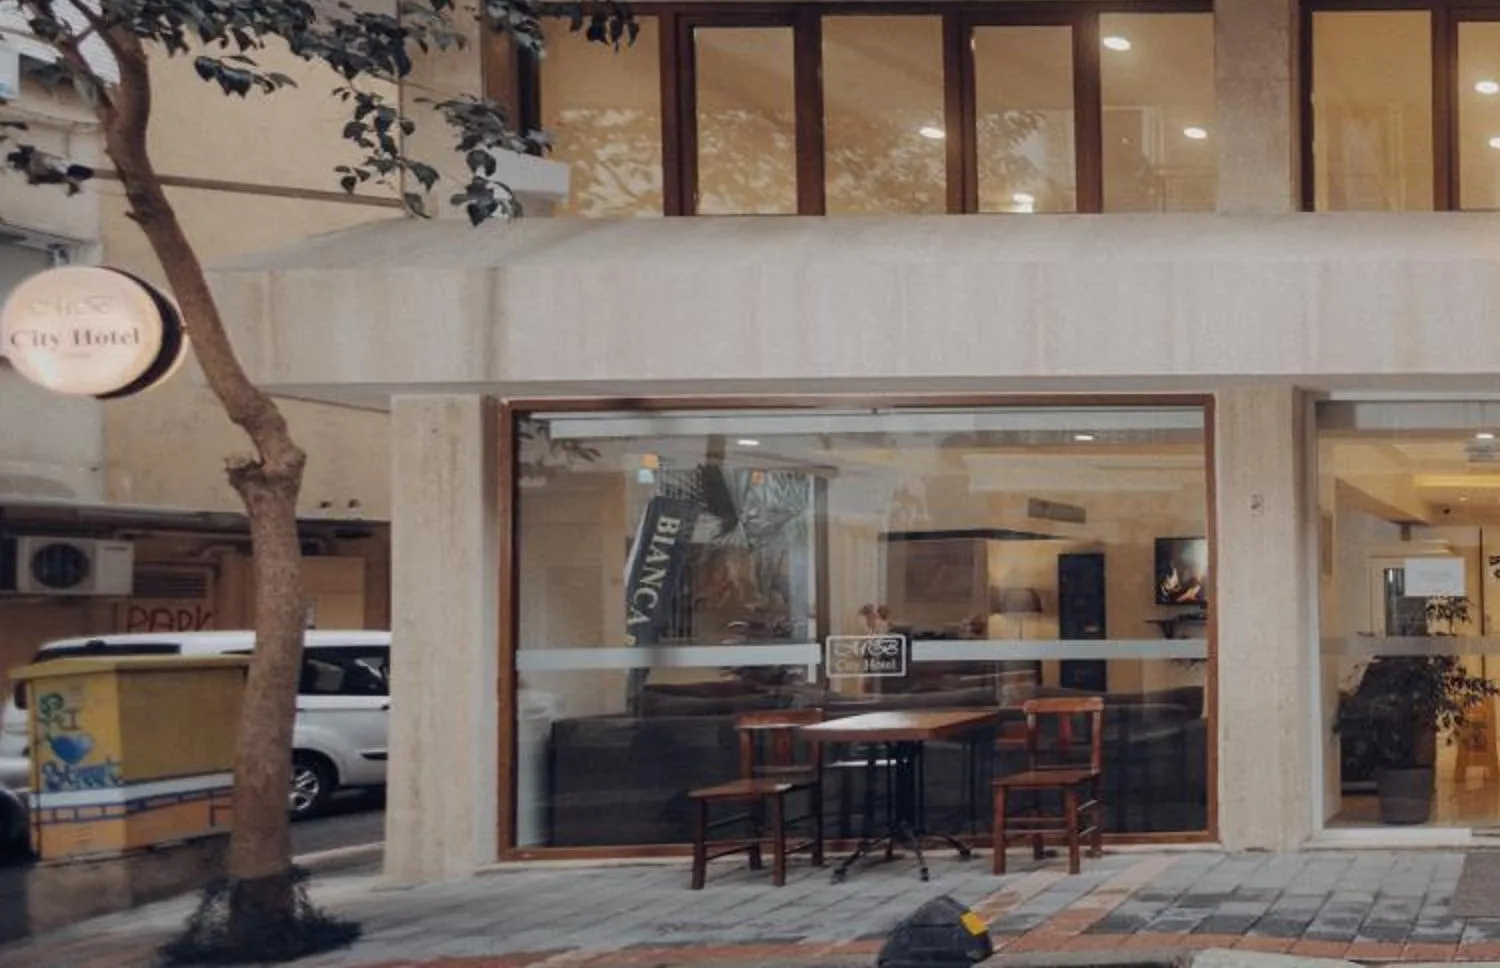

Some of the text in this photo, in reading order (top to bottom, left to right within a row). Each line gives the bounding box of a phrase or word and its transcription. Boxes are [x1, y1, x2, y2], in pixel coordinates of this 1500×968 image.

[10, 327, 140, 351] City Hotel
[627, 516, 682, 625] BIANCA
